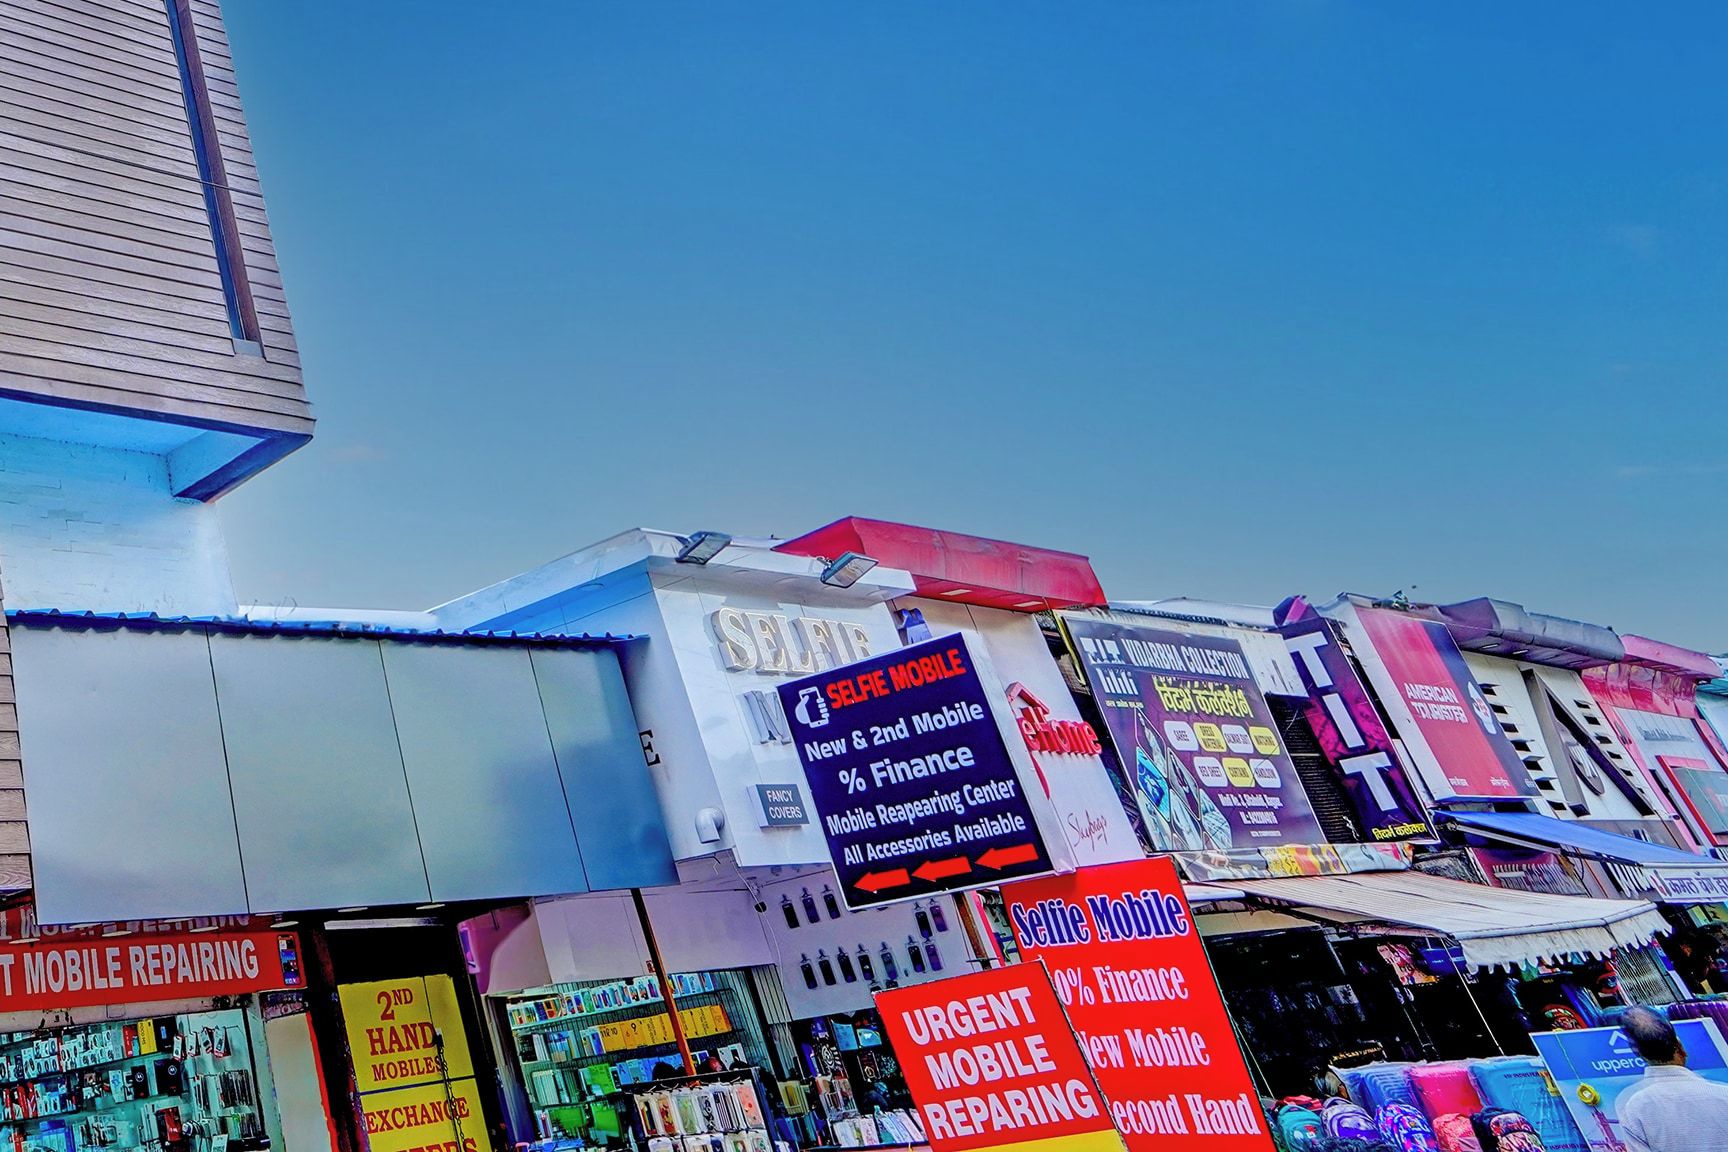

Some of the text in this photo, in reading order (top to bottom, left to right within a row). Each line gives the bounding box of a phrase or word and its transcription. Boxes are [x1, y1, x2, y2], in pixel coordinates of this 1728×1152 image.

[826, 649, 967, 709] SELFIE MOBILE
[1121, 638, 1250, 679] VIDARBHA COLLECTION
[1404, 682, 1459, 703] AMERICAN
[1411, 701, 1468, 724] TOURISTER
[805, 701, 985, 761] New & 2nd Mobile
[838, 746, 975, 794] % Finance
[766, 790, 793, 802] FANCY
[769, 806, 802, 819] COVERS
[826, 778, 1016, 836] Mobile Reapearing Center
[843, 812, 1026, 866] All Accessories Available
[1011, 889, 1189, 948] Selfie Mobile
[23, 947, 123, 996] MOBILE
[129, 939, 259, 987] REPAIRING
[1092, 965, 1188, 1004] Finance
[377, 988, 414, 1021] 2ND
[901, 986, 1036, 1045] URGENT
[366, 1022, 437, 1056] HAND
[1124, 1026, 1210, 1067] Mobile
[371, 1055, 443, 1082] MOBILES
[924, 1034, 1057, 1091] MOBILE
[364, 1097, 470, 1134] EXCHANGE
[923, 1078, 1100, 1140] REPARING
[1105, 1093, 1261, 1135] econd Hand
